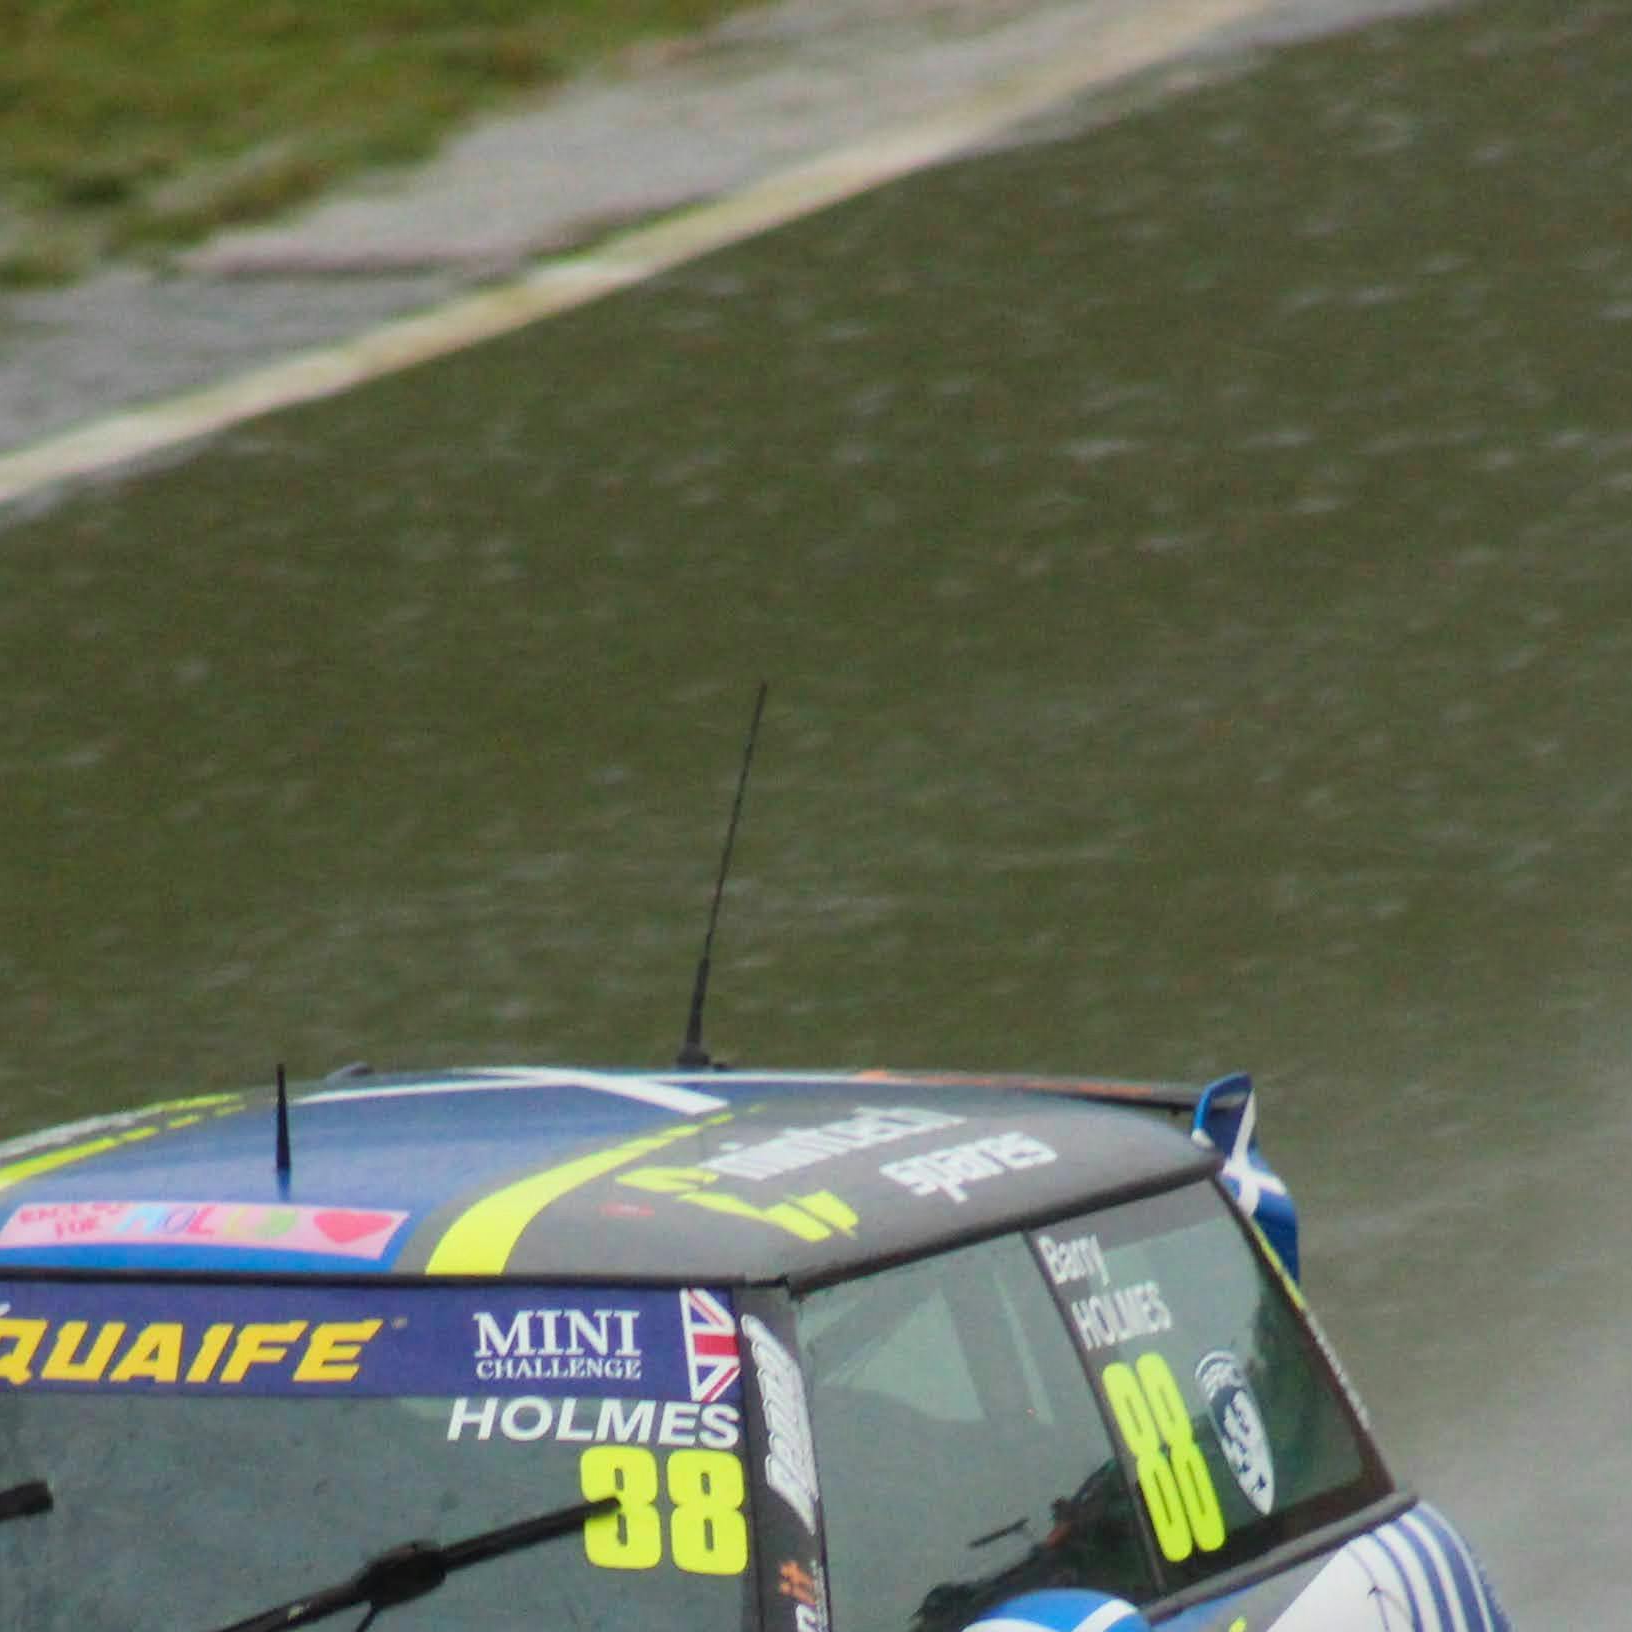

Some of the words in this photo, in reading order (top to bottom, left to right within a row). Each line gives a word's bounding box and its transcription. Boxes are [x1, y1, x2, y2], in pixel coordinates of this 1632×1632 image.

[1038, 1234, 1110, 1287] Barry
[472, 1309, 642, 1358] MINI
[1071, 1280, 1171, 1351] HOLMES
[475, 1358, 642, 1380] CHALLENGE
[446, 1396, 742, 1449] HOLMES
